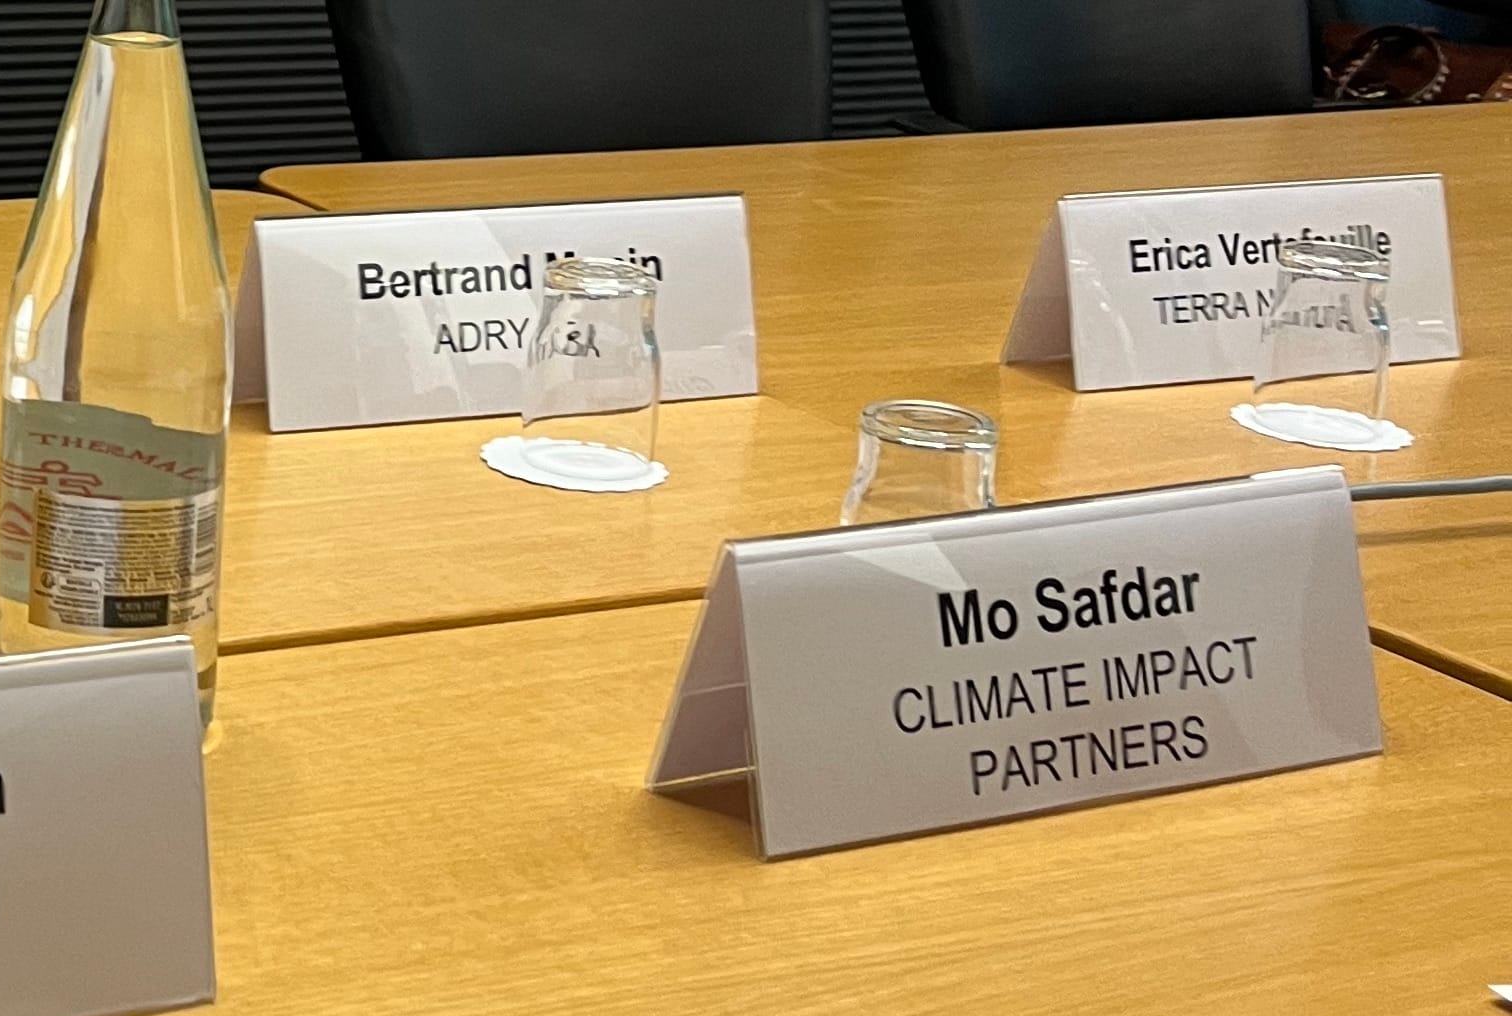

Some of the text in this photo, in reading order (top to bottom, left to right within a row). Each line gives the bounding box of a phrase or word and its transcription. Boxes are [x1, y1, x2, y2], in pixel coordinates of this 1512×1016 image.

[358, 254, 532, 299] Bertrand
[1129, 236, 1211, 273] Erica
[1153, 292, 1250, 325] TERRA
[938, 566, 1201, 648] Mo Safdar
[893, 636, 1258, 734] CLIMATE IMPACT
[969, 715, 1209, 796] PARTNERS
